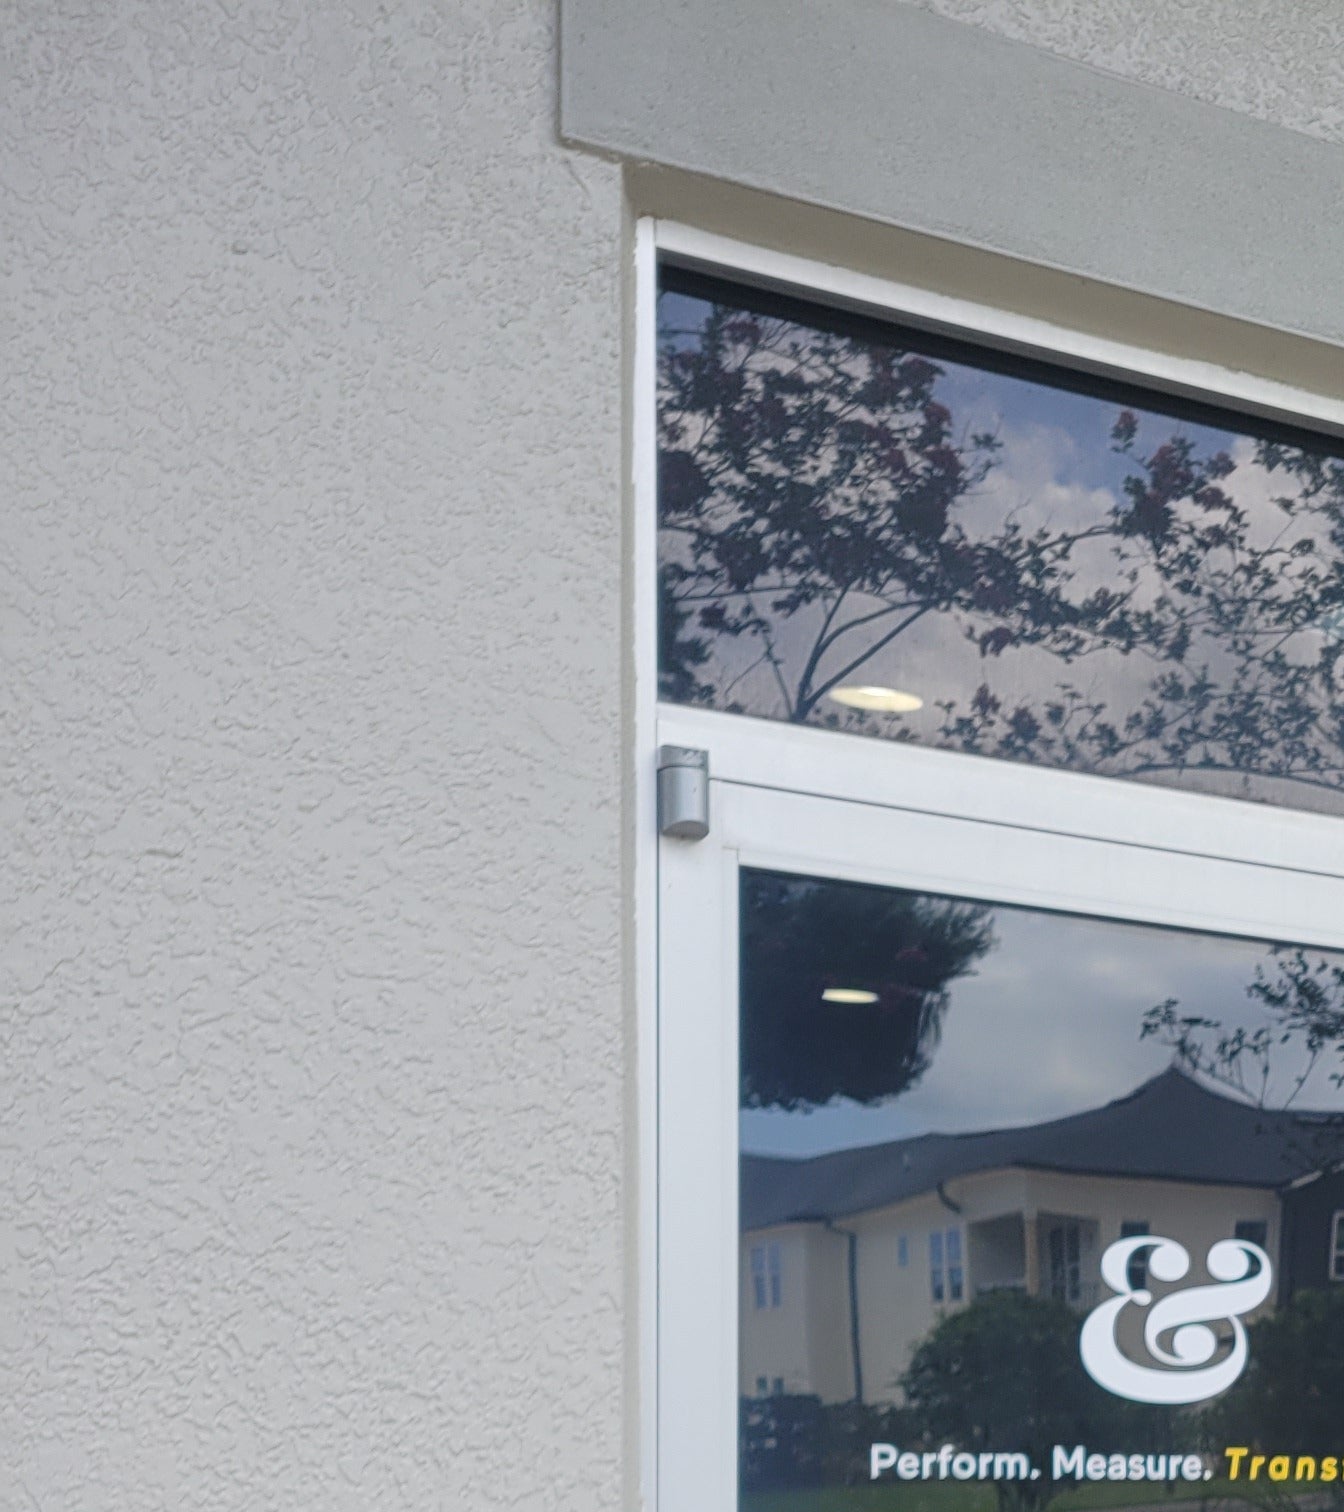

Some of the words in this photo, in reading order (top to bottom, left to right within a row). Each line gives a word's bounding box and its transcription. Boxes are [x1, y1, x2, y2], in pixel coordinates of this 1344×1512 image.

[1080, 1235, 1272, 1404] &
[870, 1443, 1040, 1480] Perform.
[1053, 1445, 1213, 1481] Measure.
